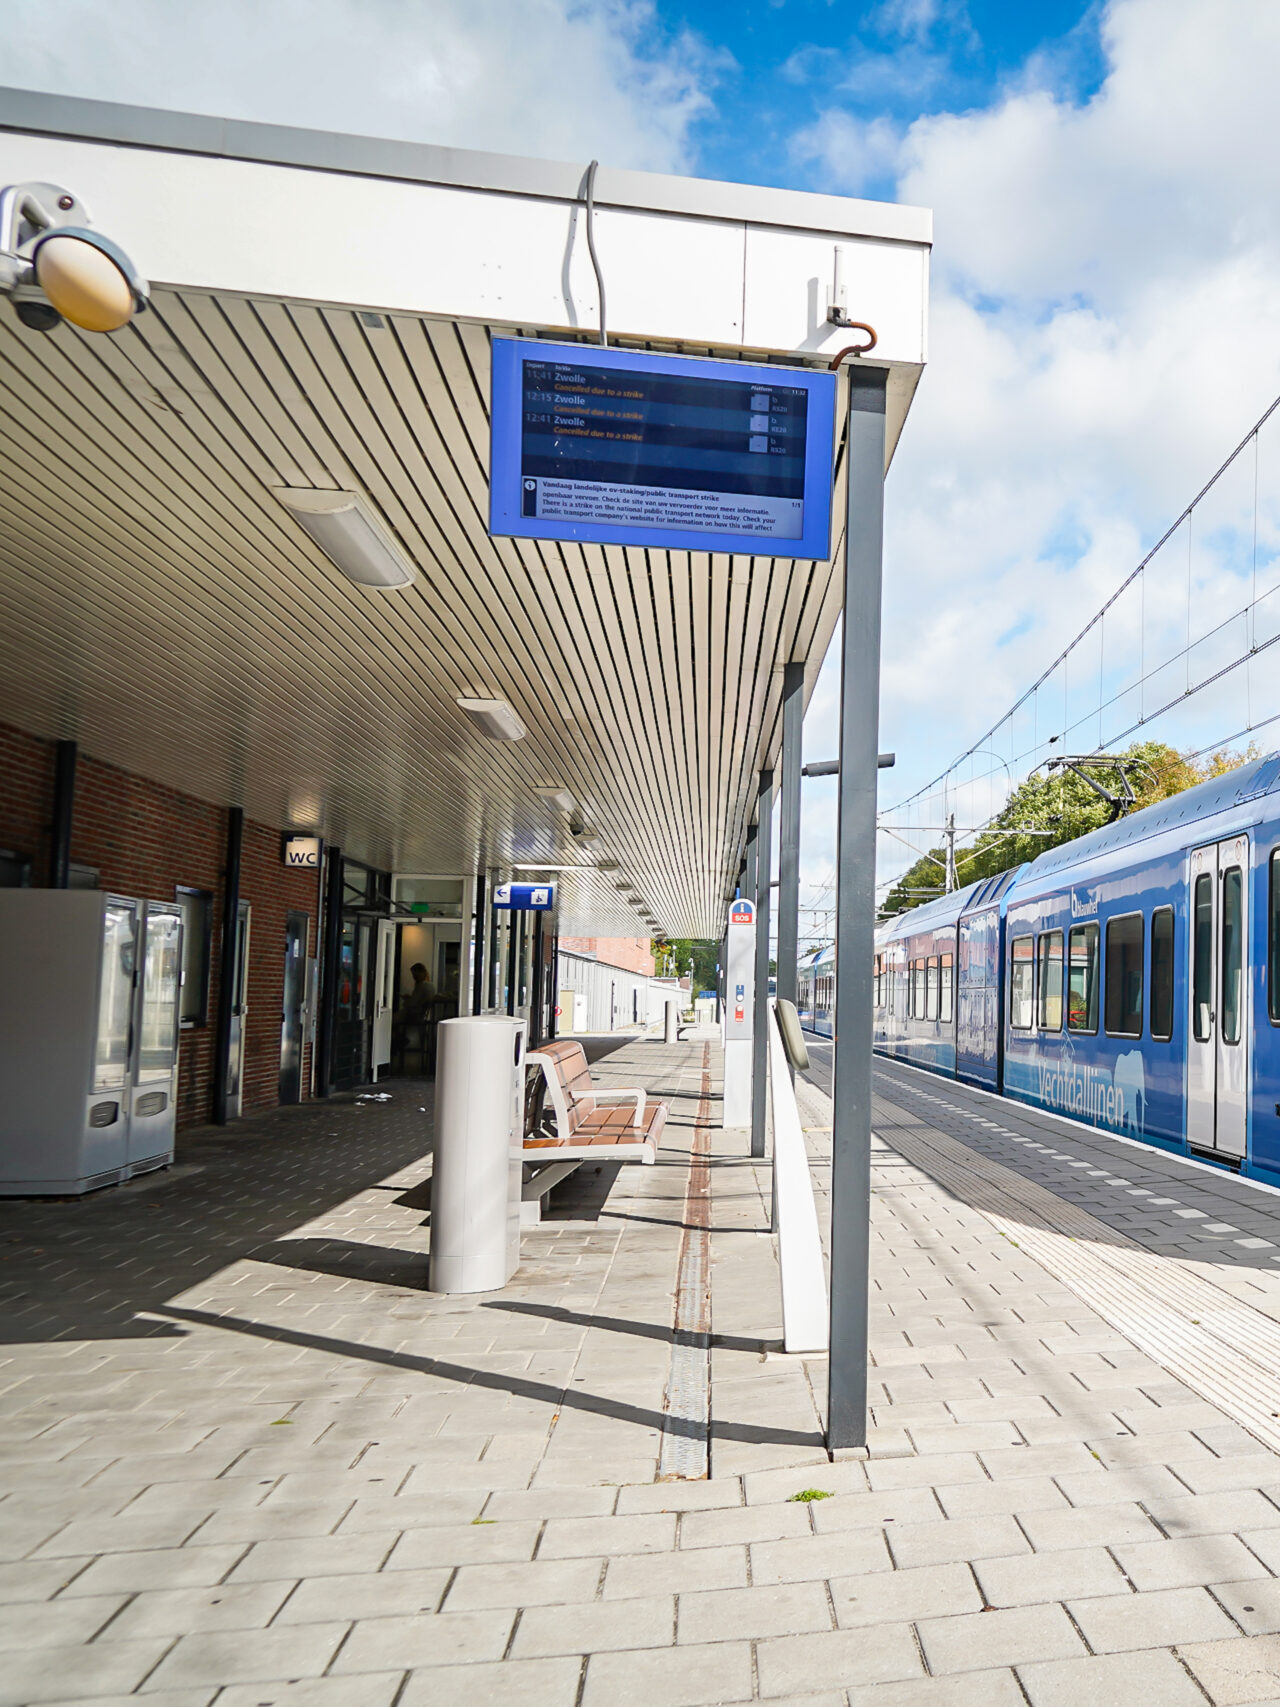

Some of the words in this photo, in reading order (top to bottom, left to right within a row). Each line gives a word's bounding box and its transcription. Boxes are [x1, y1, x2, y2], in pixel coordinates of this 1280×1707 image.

[554, 372, 586, 384] Zwolle
[554, 383, 590, 393] Cancelled
[527, 391, 552, 402] 12:15
[554, 394, 585, 405] Zwolle
[526, 413, 550, 424] 12:41
[554, 415, 585, 427] Zwolle
[553, 405, 589, 415] Cancelled
[591, 408, 605, 416] due
[622, 412, 644, 420] strike
[553, 426, 589, 436] Cancelled
[622, 433, 643, 441] strike
[542, 481, 572, 491] Vandaag
[574, 483, 608, 493] landelijke
[668, 491, 699, 501] transport
[700, 494, 720, 502] strike
[542, 491, 573, 499] openbaar
[601, 495, 620, 503] Check
[669, 502, 703, 510] vervoerder
[542, 498, 560, 506] There
[575, 501, 593, 509] strike
[616, 505, 643, 513] national
[644, 507, 663, 515] public
[665, 509, 694, 518] transport
[742, 515, 761, 523] Check
[563, 509, 594, 517] transport
[594, 512, 628, 520] company's
[629, 514, 655, 522] website
[666, 517, 704, 526] information
[754, 524, 773, 532] affect
[289, 851, 316, 864] WC
[734, 914, 750, 922] SOS
[1038, 1060, 1124, 1128] Vechtdallijnen
